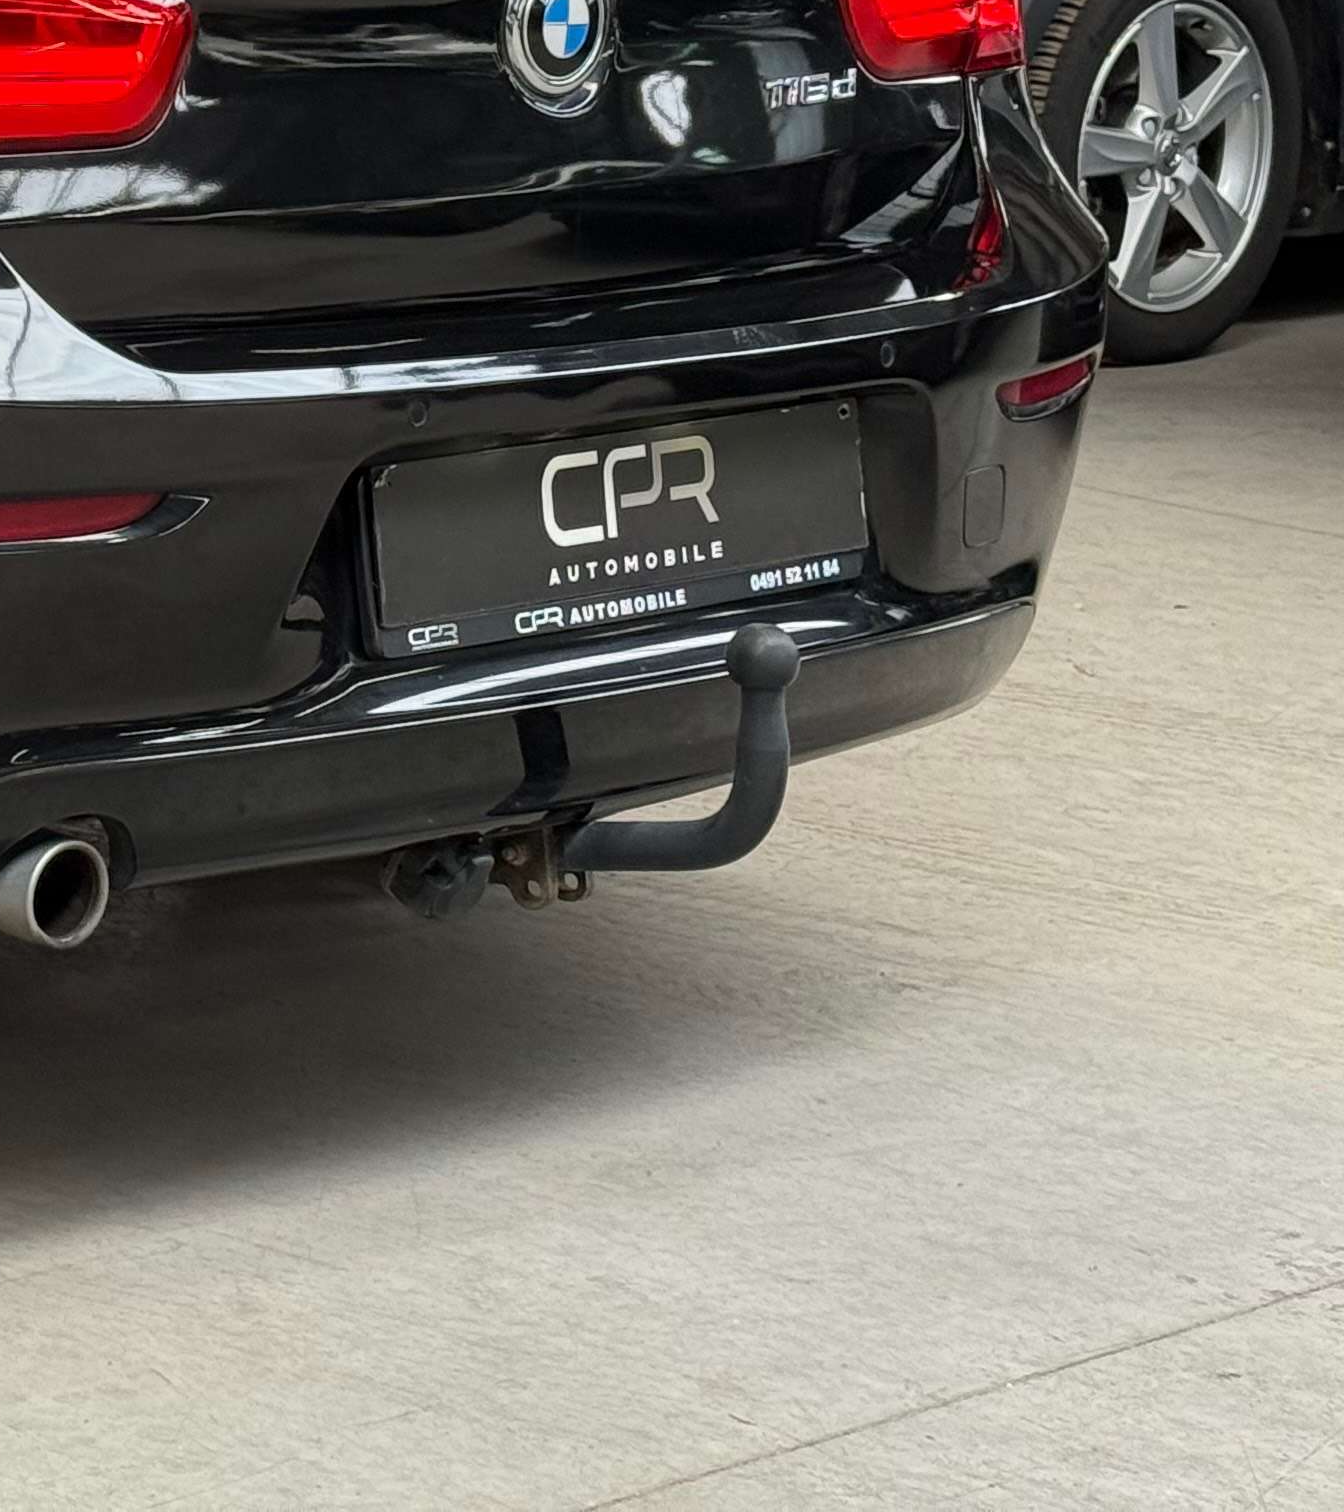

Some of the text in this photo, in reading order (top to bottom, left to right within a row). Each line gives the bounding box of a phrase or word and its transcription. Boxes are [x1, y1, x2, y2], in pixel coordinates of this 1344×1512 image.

[540, 434, 720, 548] CPR
[548, 540, 724, 587] AUTOMOBILE
[750, 569, 782, 592] 0491
[785, 566, 803, 585] 52
[804, 561, 820, 581] 11
[514, 588, 688, 634] CPR AUTOMOBILE
